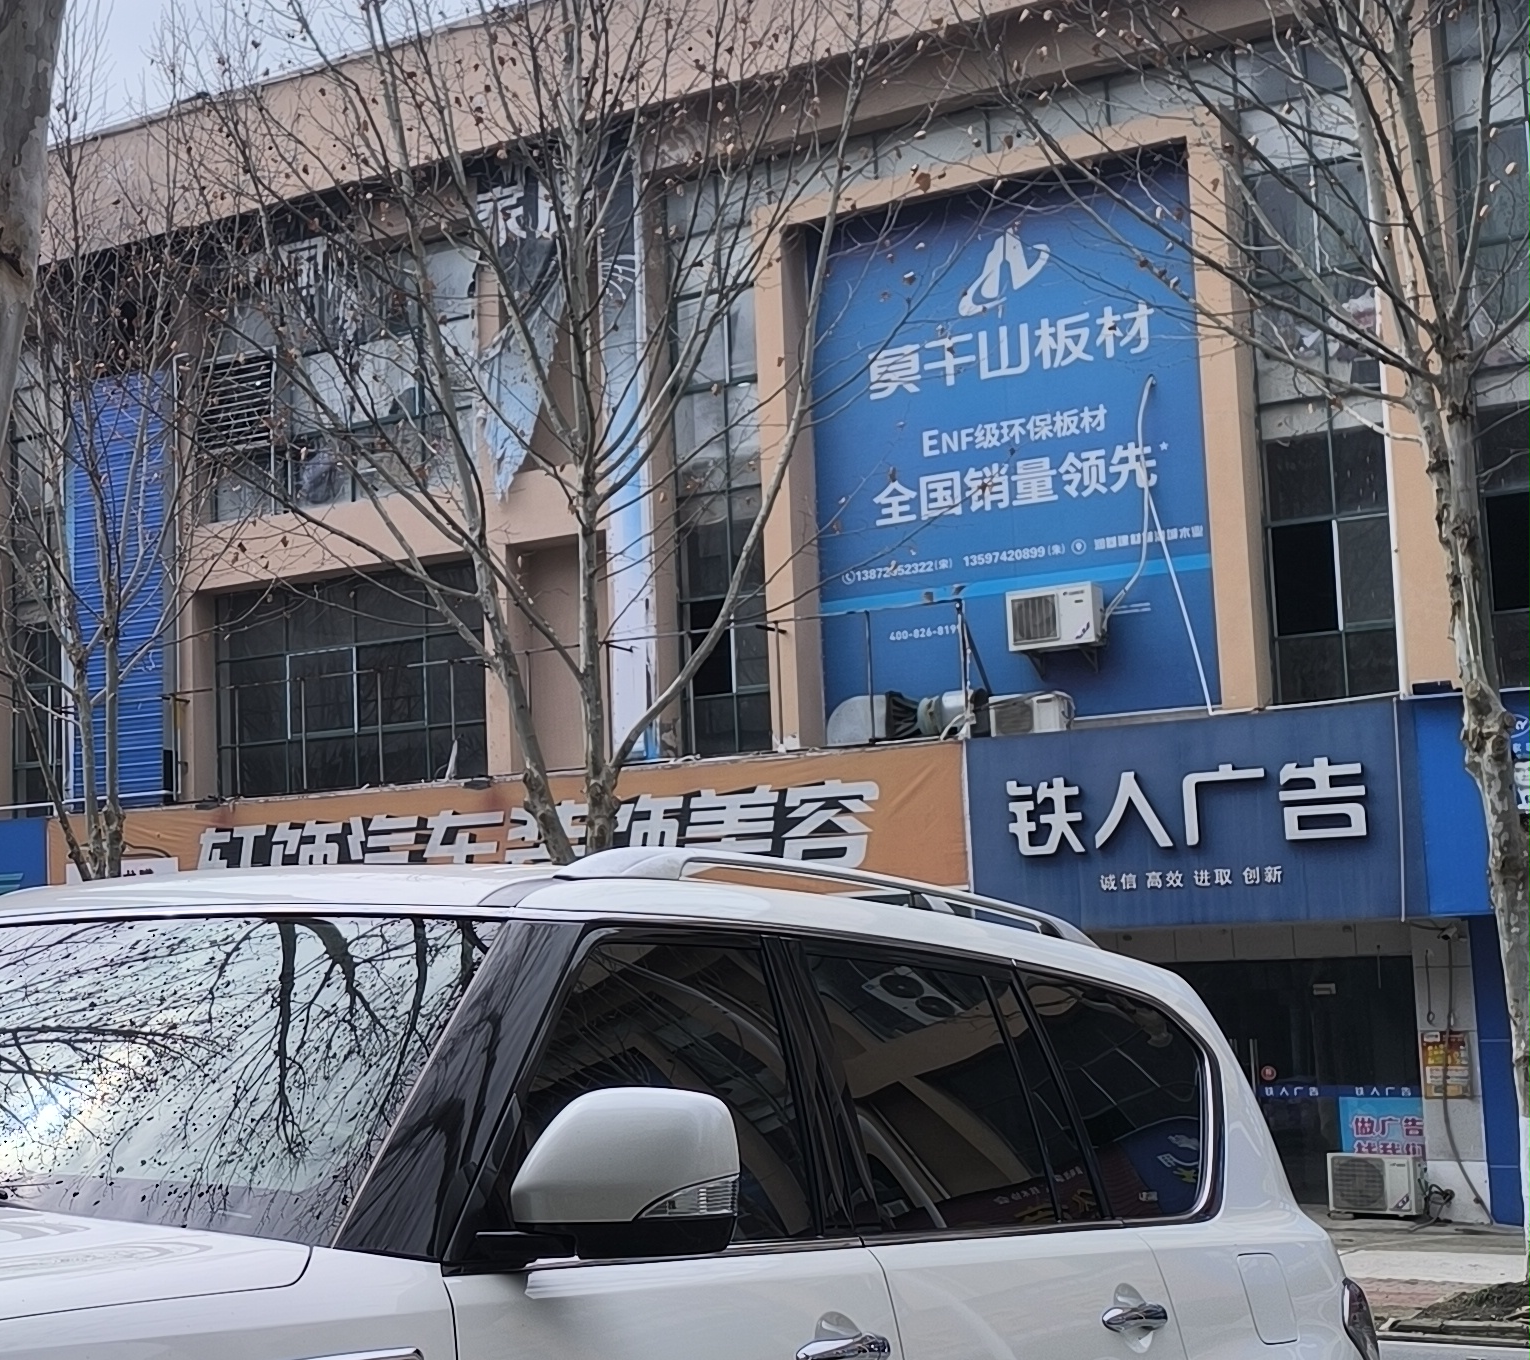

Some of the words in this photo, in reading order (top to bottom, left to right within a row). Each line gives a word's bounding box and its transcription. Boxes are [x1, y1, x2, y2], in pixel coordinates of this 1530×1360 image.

[868, 301, 1156, 401] 莫干山板材
[922, 404, 1108, 458] ENF级环保板材
[872, 441, 1159, 527] 全国销量领先
[889, 624, 961, 641] 400-826-819
[1006, 757, 1368, 857] 铁人广告
[1099, 871, 1137, 892] 诚信
[1145, 869, 1184, 890] 高效
[1193, 867, 1233, 887] 进取
[1242, 864, 1283, 885] 创新
[1352, 1115, 1424, 1138] 做广告
